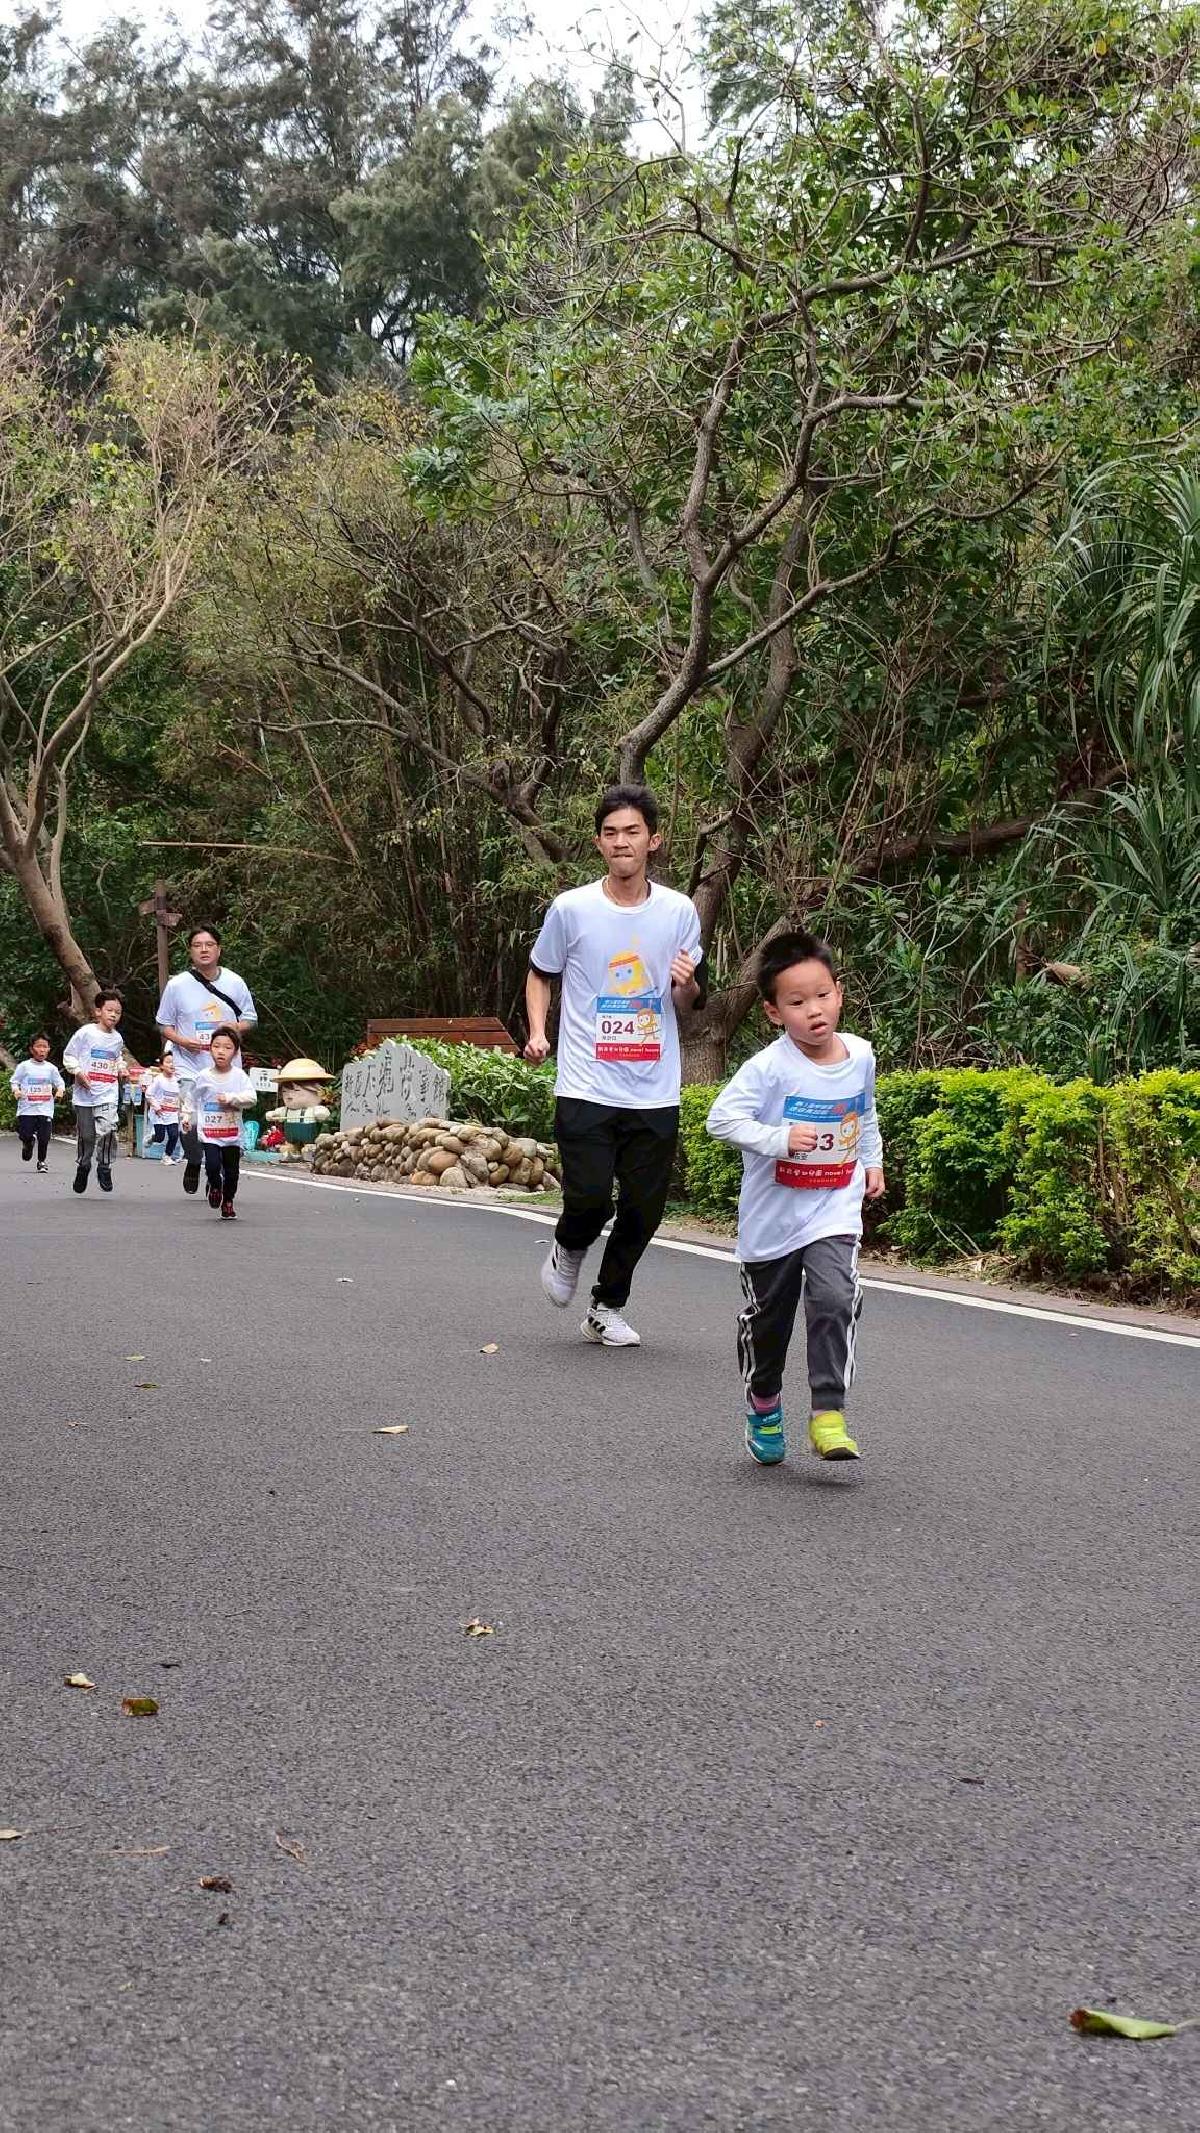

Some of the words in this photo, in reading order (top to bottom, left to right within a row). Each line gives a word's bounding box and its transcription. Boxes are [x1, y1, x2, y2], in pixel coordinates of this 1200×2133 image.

[601, 1020, 635, 1035] 024
[91, 1062, 108, 1070] 430
[204, 1115, 223, 1124] 027
